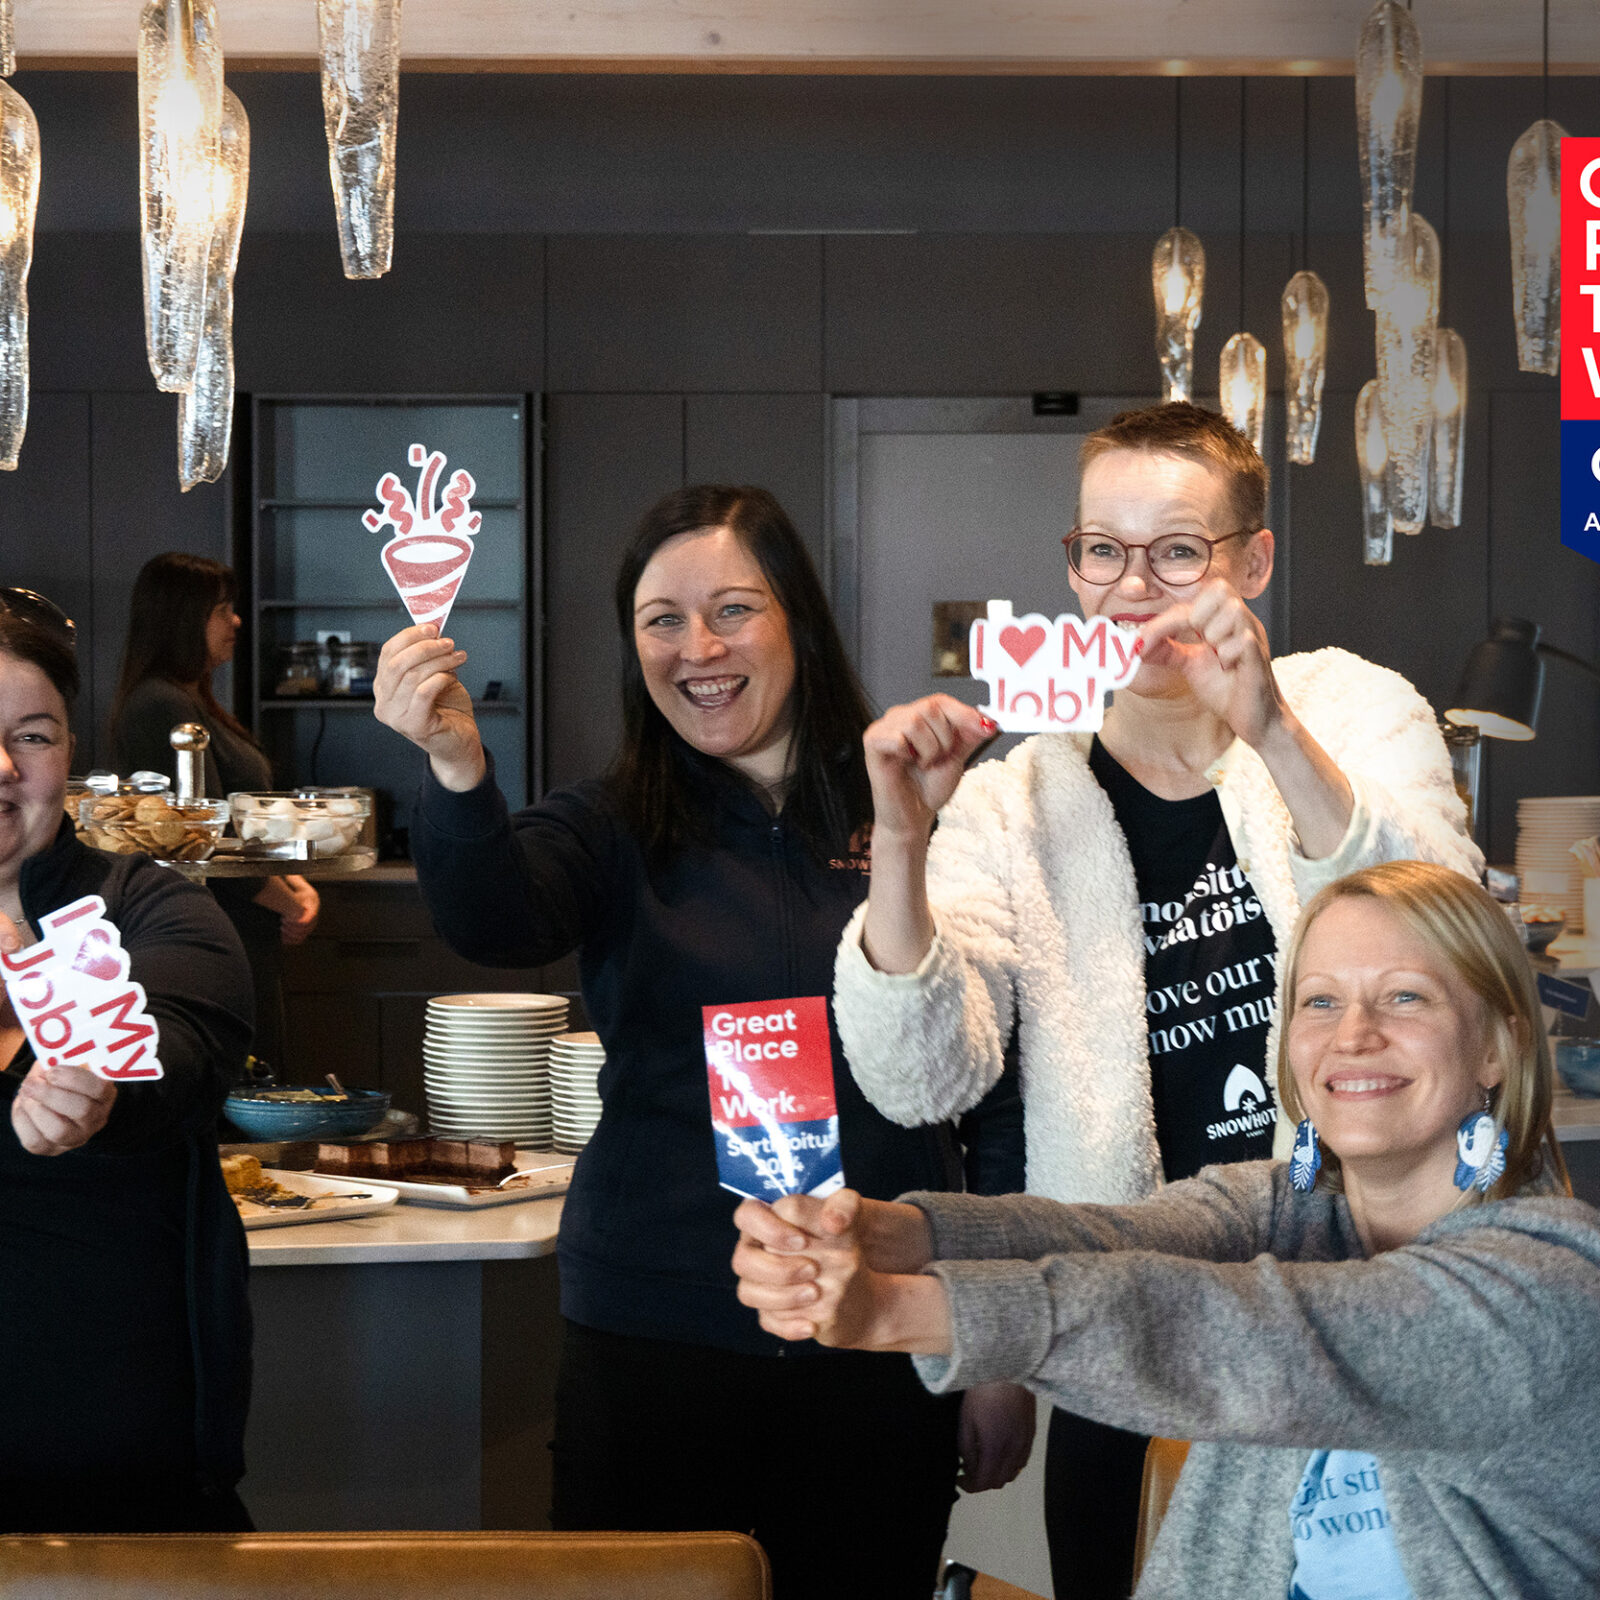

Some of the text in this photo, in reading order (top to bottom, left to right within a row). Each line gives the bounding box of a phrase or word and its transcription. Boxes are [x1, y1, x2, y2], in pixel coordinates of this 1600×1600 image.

[976, 622, 1137, 681] I My
[51, 901, 159, 1079] I My
[1205, 957, 1263, 996] our
[712, 1009, 797, 1037] Great
[1149, 1015, 1217, 1055] now
[715, 1039, 799, 1063] Place
[1206, 1107, 1277, 1140] SNOWHOT
